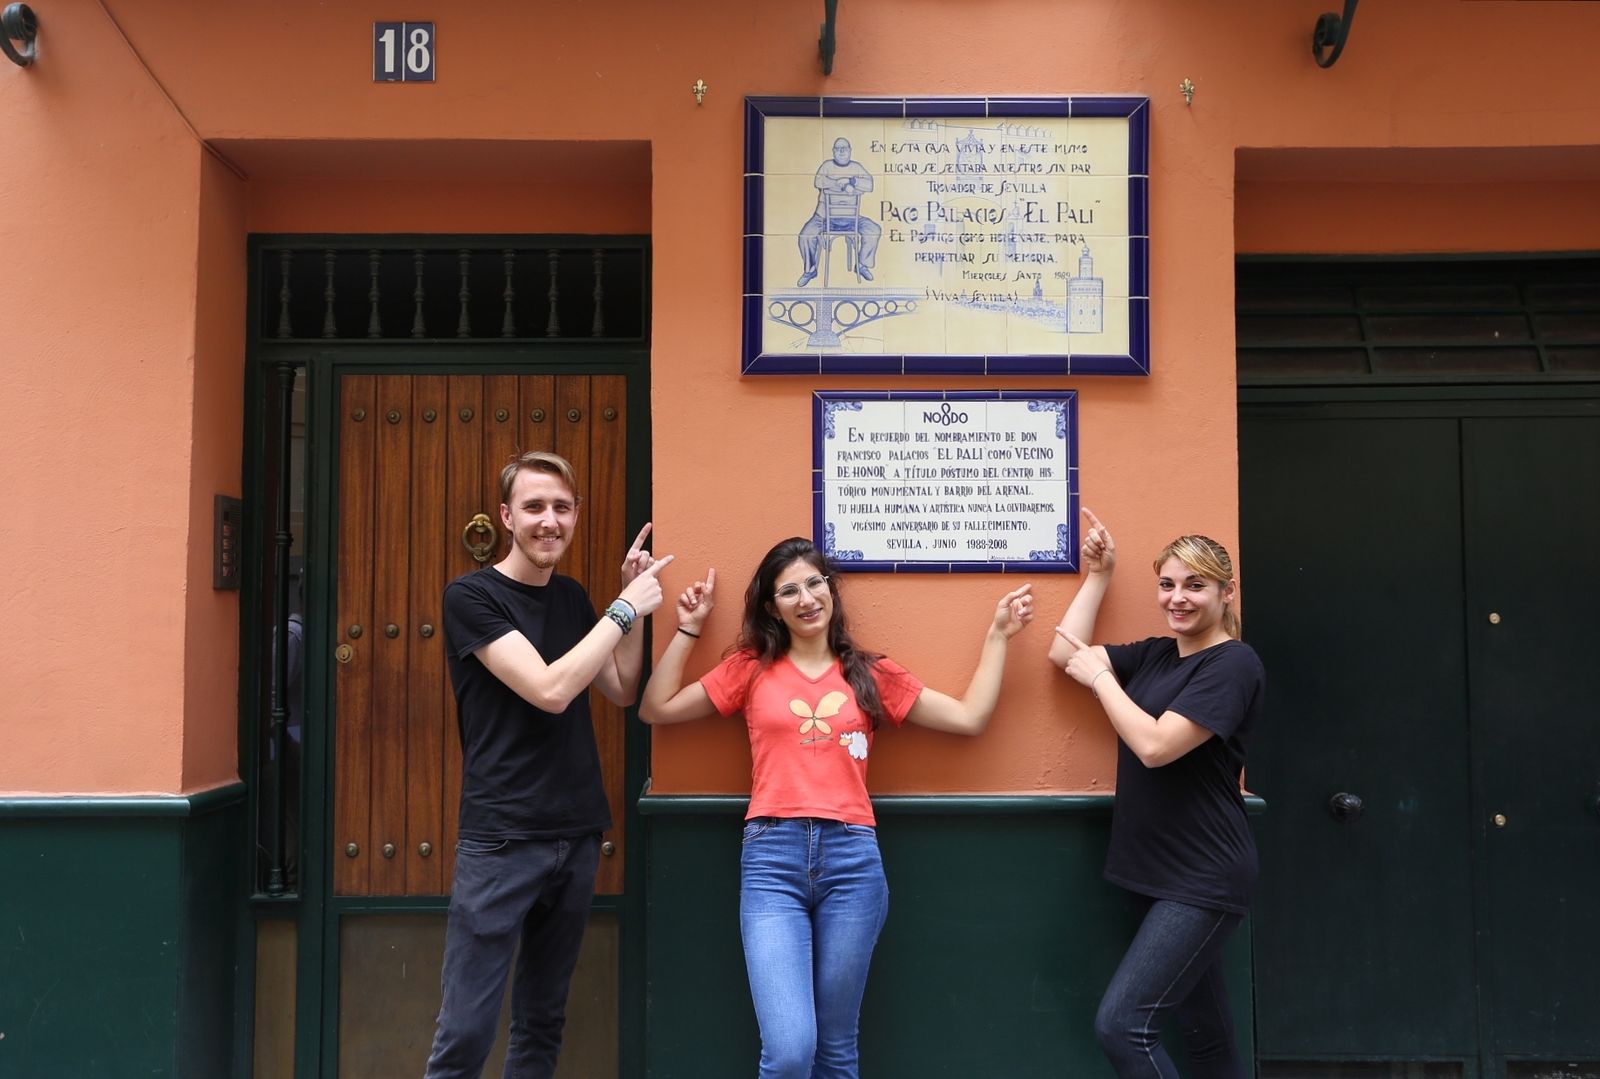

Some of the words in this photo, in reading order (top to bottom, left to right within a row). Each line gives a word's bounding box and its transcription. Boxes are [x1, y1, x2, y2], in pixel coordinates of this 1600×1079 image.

[379, 28, 430, 73] 18
[870, 140, 886, 153] EN
[891, 143, 920, 155] ESTA
[925, 143, 950, 154] CASA
[987, 143, 996, 154] Y
[1001, 144, 1015, 153] EN
[1020, 144, 1048, 154] ESTE
[1054, 144, 1088, 155] MISMO
[884, 163, 917, 174] LUGAR
[920, 163, 937, 175] SE
[939, 163, 988, 175] SENTABA
[993, 163, 1042, 174] NUESTRO
[1045, 163, 1065, 175] SIN
[1071, 164, 1091, 175] PAR
[926, 180, 976, 195] TROVADOR
[980, 183, 994, 193] DE
[994, 180, 1047, 196] SEVILLA
[880, 200, 919, 224] PACO
[926, 201, 1007, 225] PALACIOS
[889, 229, 905, 242] EL
[910, 229, 954, 245] POSTIGO
[959, 232, 985, 245] COMO
[1054, 233, 1086, 245] PARA
[914, 252, 975, 264] PERPETUAR
[982, 252, 998, 265] SU
[962, 270, 1007, 282] MIERCOLES
[1012, 270, 1042, 282] SANTO
[848, 427, 865, 443] EN
[870, 432, 910, 445] RECUERDO
[915, 433, 930, 443] DEL
[934, 432, 1001, 443] NOMBRAMIENTO
[1005, 432, 1016, 442] DE
[1021, 432, 1037, 442] DON
[837, 450, 881, 461] FRANCISCO
[888, 450, 929, 461] PALACIOS
[987, 450, 1012, 460] COMO
[837, 466, 850, 478] DE
[894, 468, 900, 478] A
[904, 465, 937, 479] TÍTULO
[940, 465, 979, 479] PÓSTUMO
[983, 467, 999, 478] DEL
[1002, 467, 1034, 480] CENTRO
[837, 484, 867, 498] TÓRICO
[871, 486, 933, 497] MONUMENTAL
[935, 486, 941, 496] Y
[944, 485, 973, 497] BARRIO
[977, 485, 992, 496] DEL
[995, 485, 1034, 497] ARENAL.
[837, 503, 847, 514] TU
[850, 503, 880, 514] HUELLA
[884, 503, 920, 514] HUMANA
[922, 503, 928, 513] Y
[929, 501, 965, 515] ARTÍSTICA
[967, 503, 992, 513] NUNCA
[995, 503, 1006, 513] LA
[850, 520, 886, 531] VIGÉSIMO
[890, 520, 938, 533] ANIVERSARIO
[941, 520, 950, 531] DE
[952, 520, 961, 531] SU
[964, 520, 1031, 531] FALLECIMIENTO.
[886, 538, 921, 549] SEVILLA
[932, 538, 957, 549] JUNIO
[966, 538, 1008, 550] 1988-2008
